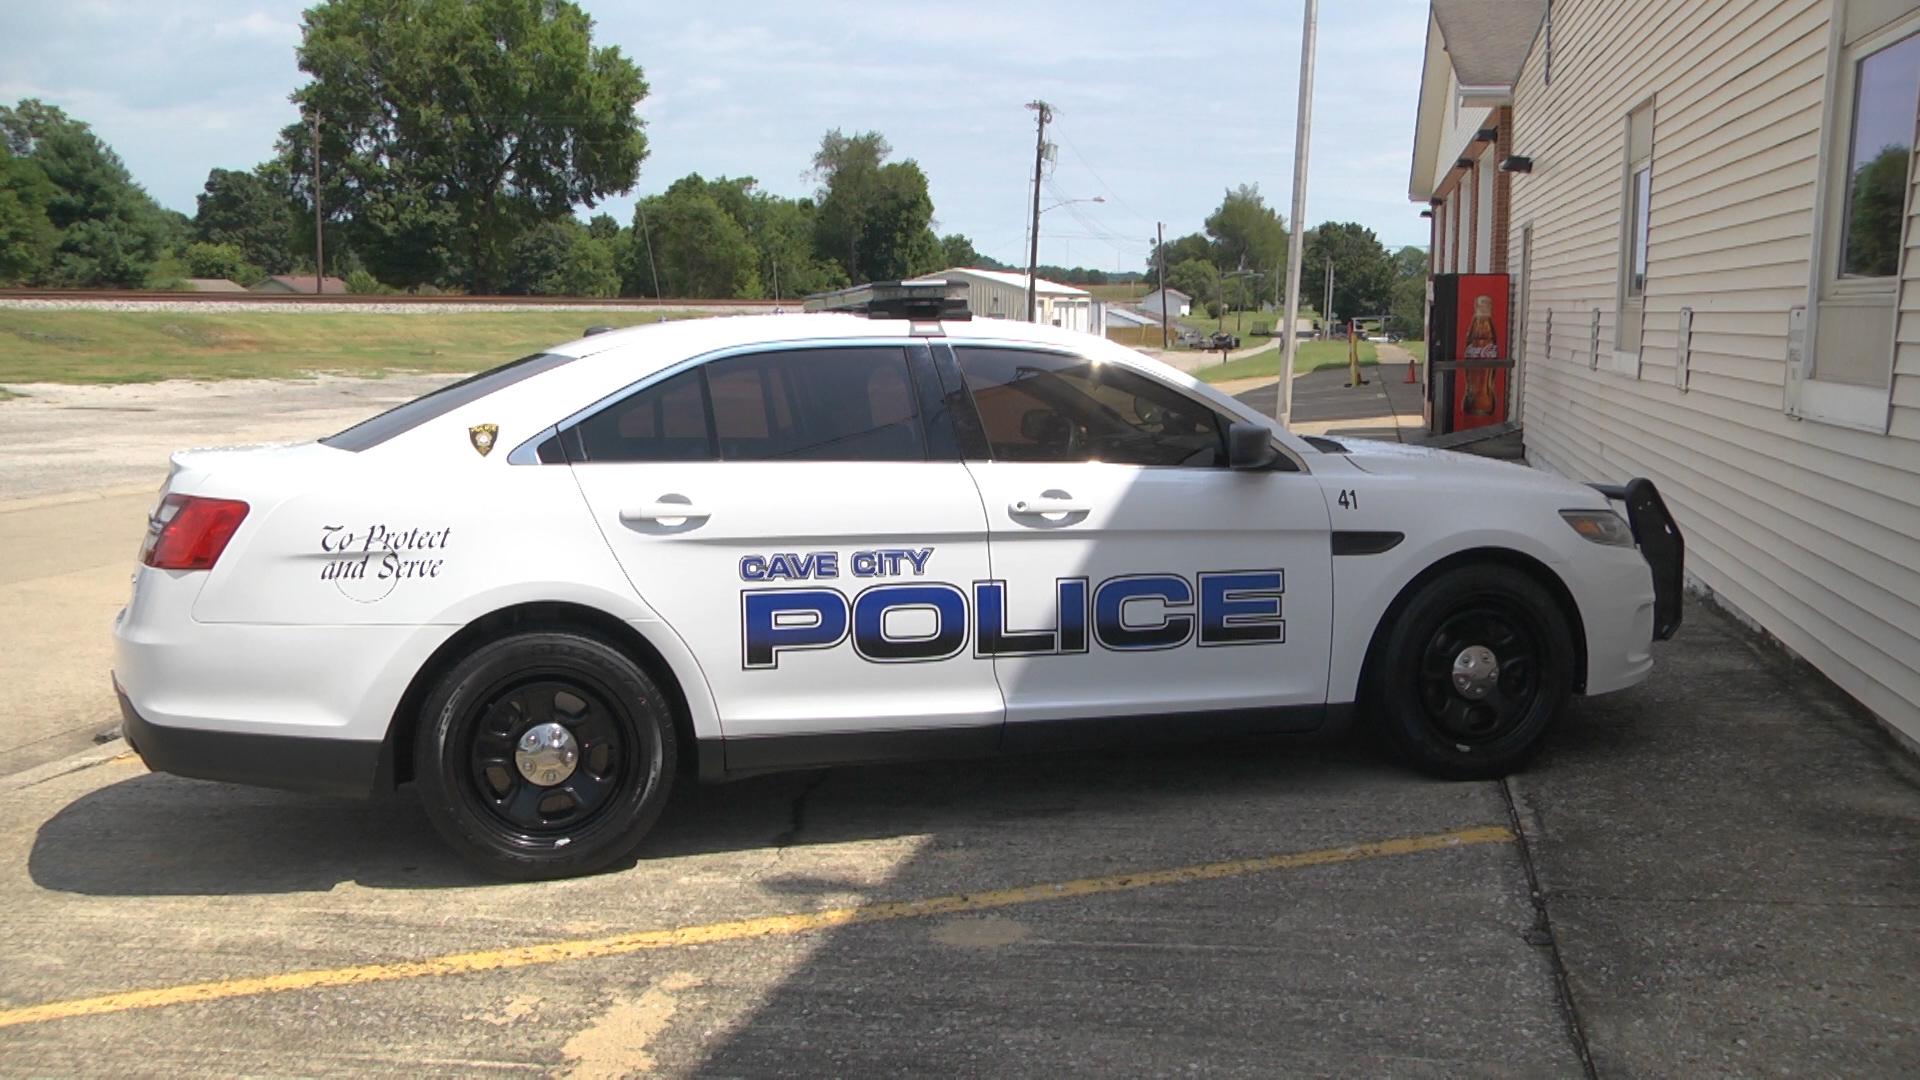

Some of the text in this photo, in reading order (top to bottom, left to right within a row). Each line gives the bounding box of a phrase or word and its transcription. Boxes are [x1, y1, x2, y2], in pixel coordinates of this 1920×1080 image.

[1338, 489, 1357, 510] 41
[321, 524, 451, 552] To Protect
[321, 552, 444, 580] and Serve
[739, 547, 935, 582] CAVE CITY
[741, 568, 1286, 671] POLICE
